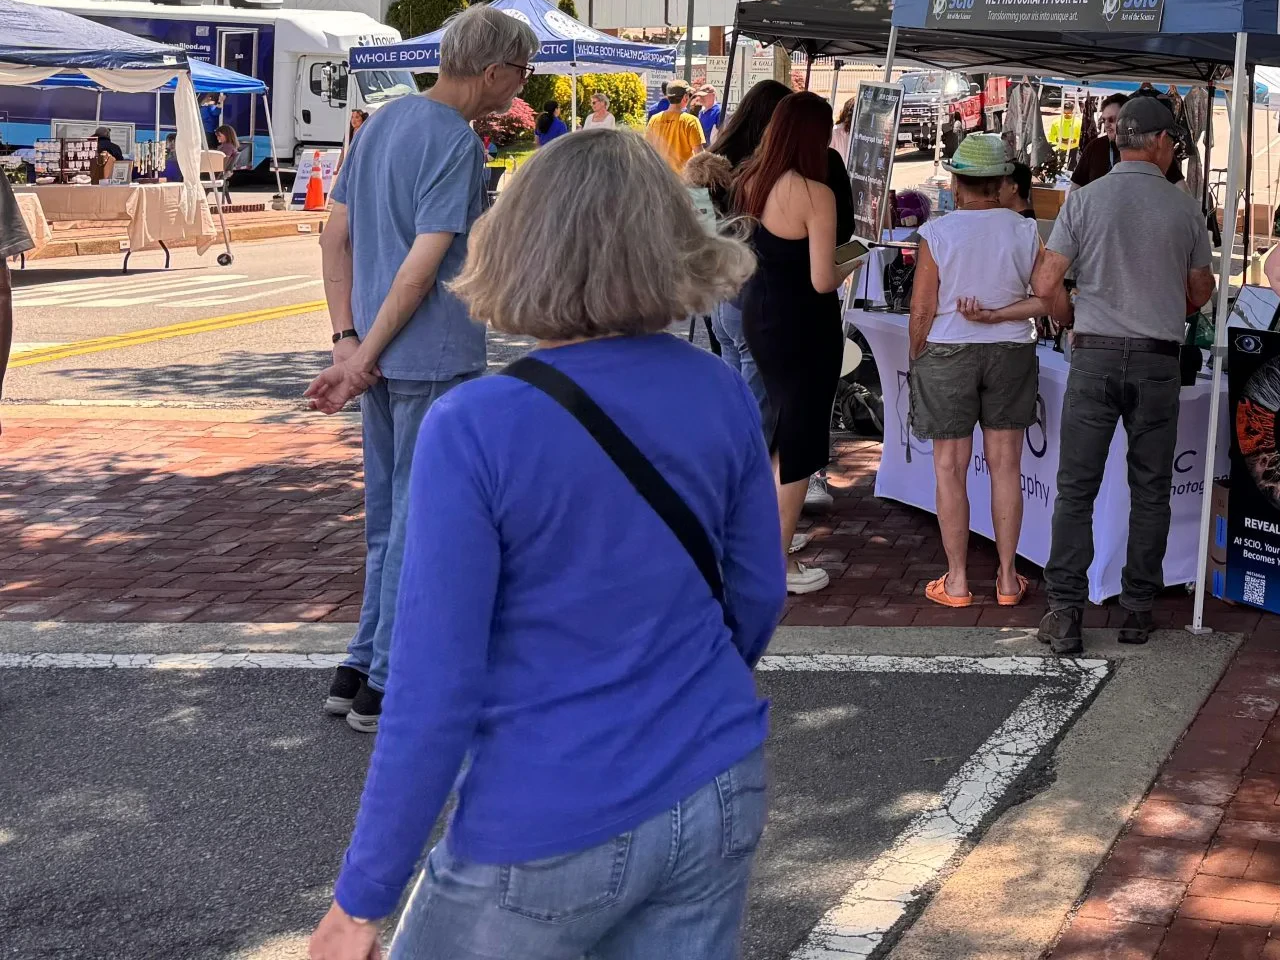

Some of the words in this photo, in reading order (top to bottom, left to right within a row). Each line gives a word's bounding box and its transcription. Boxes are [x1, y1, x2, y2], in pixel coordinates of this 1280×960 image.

[988, 10, 1019, 22] Transforming
[1019, 14, 1031, 22] your
[1050, 12, 1069, 22] unique
[371, 34, 396, 45] Inova
[355, 52, 397, 64] WHOLE
[400, 49, 431, 61] BODY
[577, 44, 599, 56] WHOLE
[600, 45, 616, 57] BODY
[616, 48, 637, 60] HEALTH
[637, 50, 674, 65] CHIROPRACTIC
[863, 151, 870, 169] 2
[857, 191, 865, 206] 3
[1244, 517, 1280, 535] REVEAL
[1233, 536, 1242, 545] At
[1244, 538, 1262, 551] SCIO,
[1264, 542, 1280, 554] Your
[1243, 549, 1275, 565] Becomes
